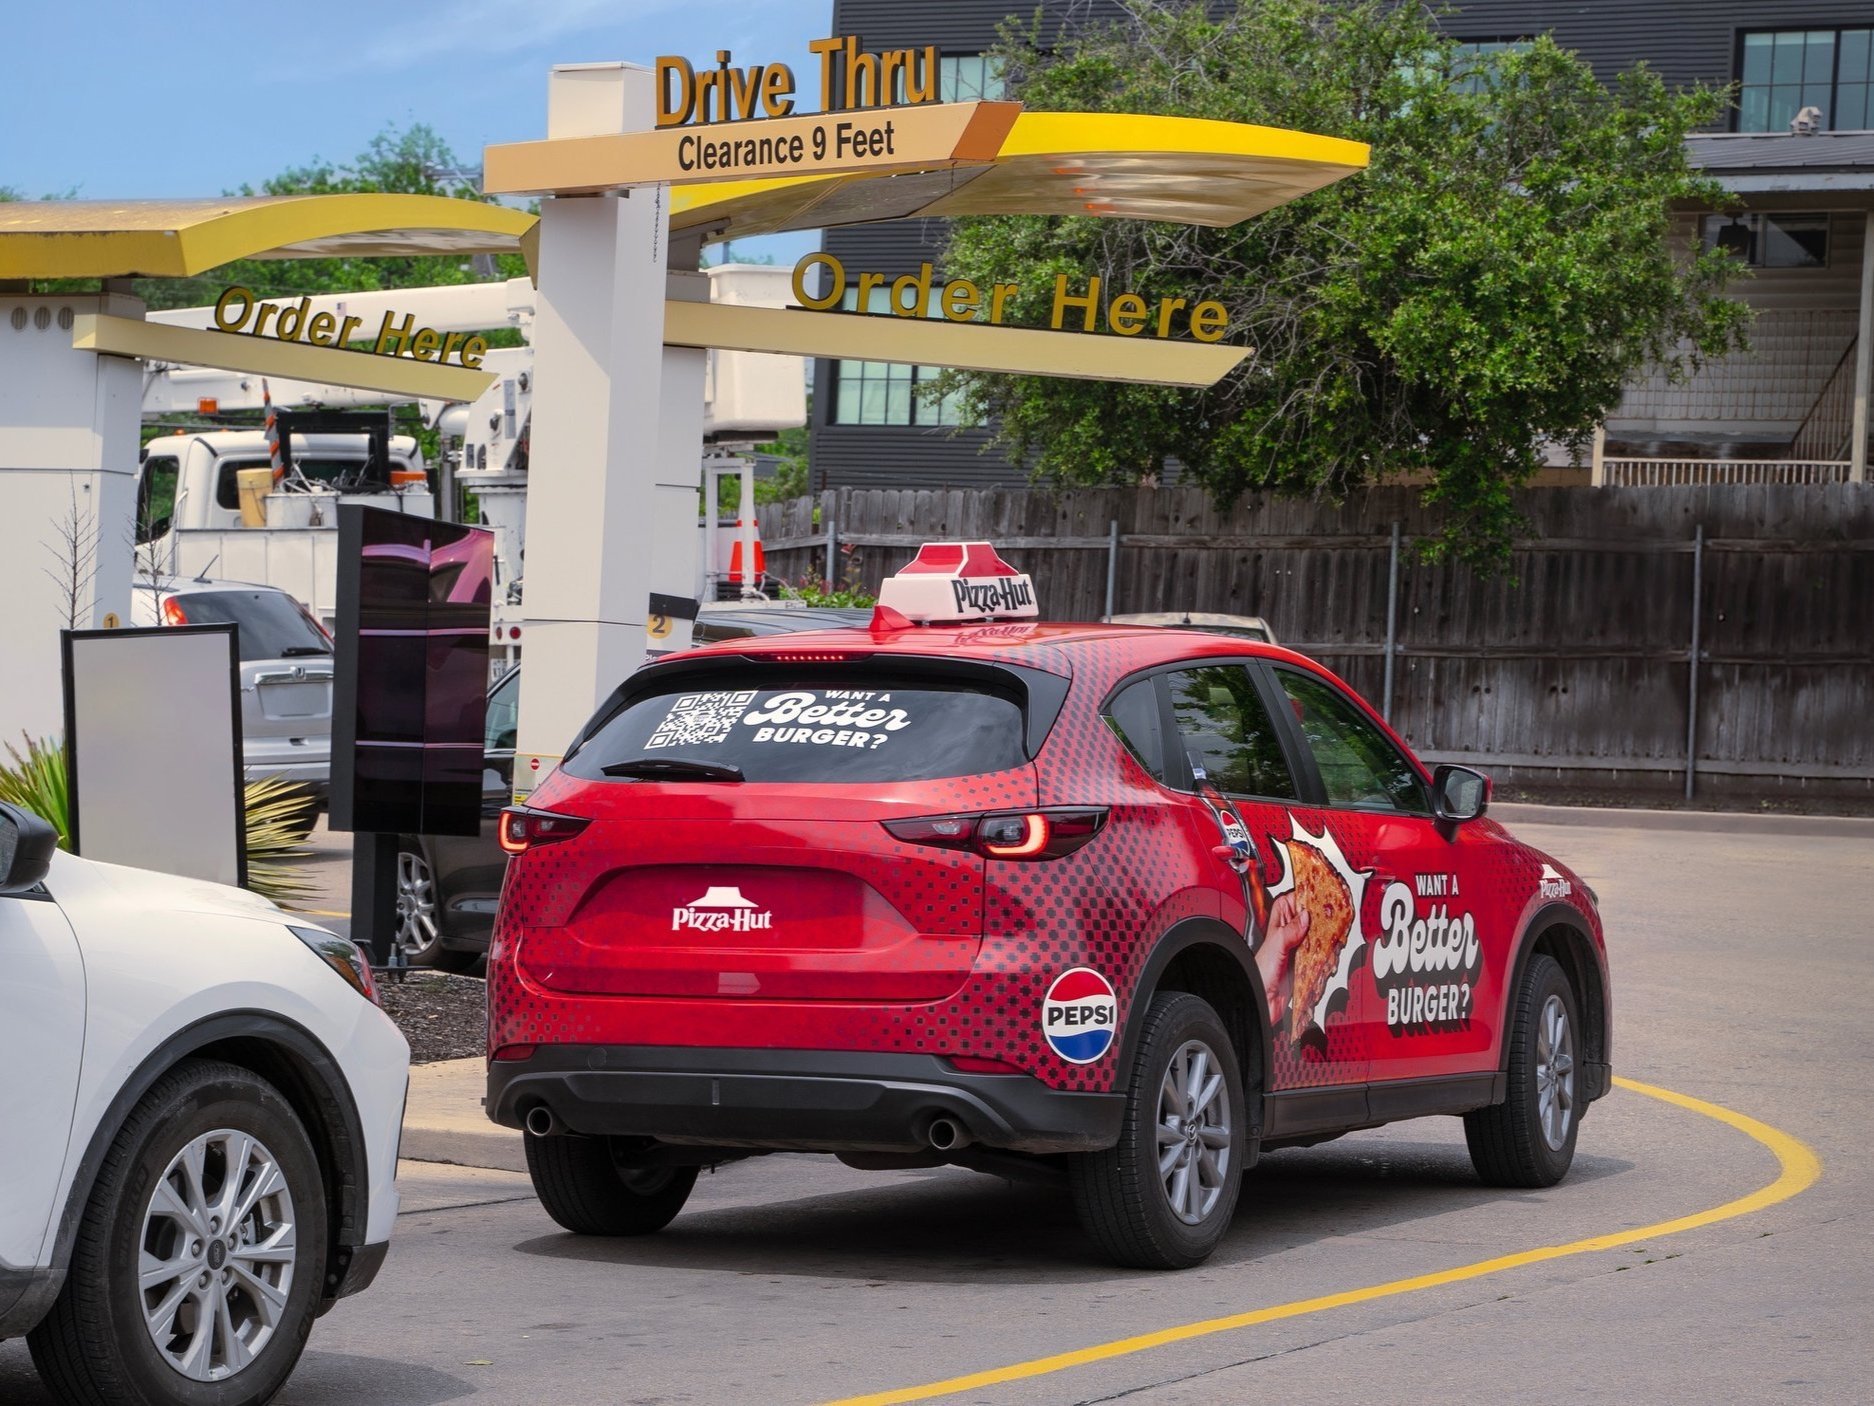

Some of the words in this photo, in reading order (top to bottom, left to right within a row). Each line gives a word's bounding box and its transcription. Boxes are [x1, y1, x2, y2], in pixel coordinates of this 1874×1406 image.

[656, 50, 796, 127] Drive
[809, 35, 941, 112] Thru
[678, 135, 803, 171] Clearance
[812, 126, 826, 160] 9
[836, 121, 894, 158] Feet
[792, 251, 1018, 324] Order
[1050, 273, 1229, 342] Here
[214, 285, 363, 349] Order
[374, 310, 488, 369] Here
[652, 614, 666, 633] 2
[743, 692, 912, 731] Better
[825, 690, 876, 701] WANT
[878, 693, 891, 703] A
[752, 727, 889, 749] BURGER?
[1415, 874, 1448, 896] WANT
[1451, 874, 1459, 896] A
[1373, 882, 1479, 979] Better
[1048, 1005, 1114, 1026] PEPSI
[1388, 983, 1470, 1025] BURGER?
